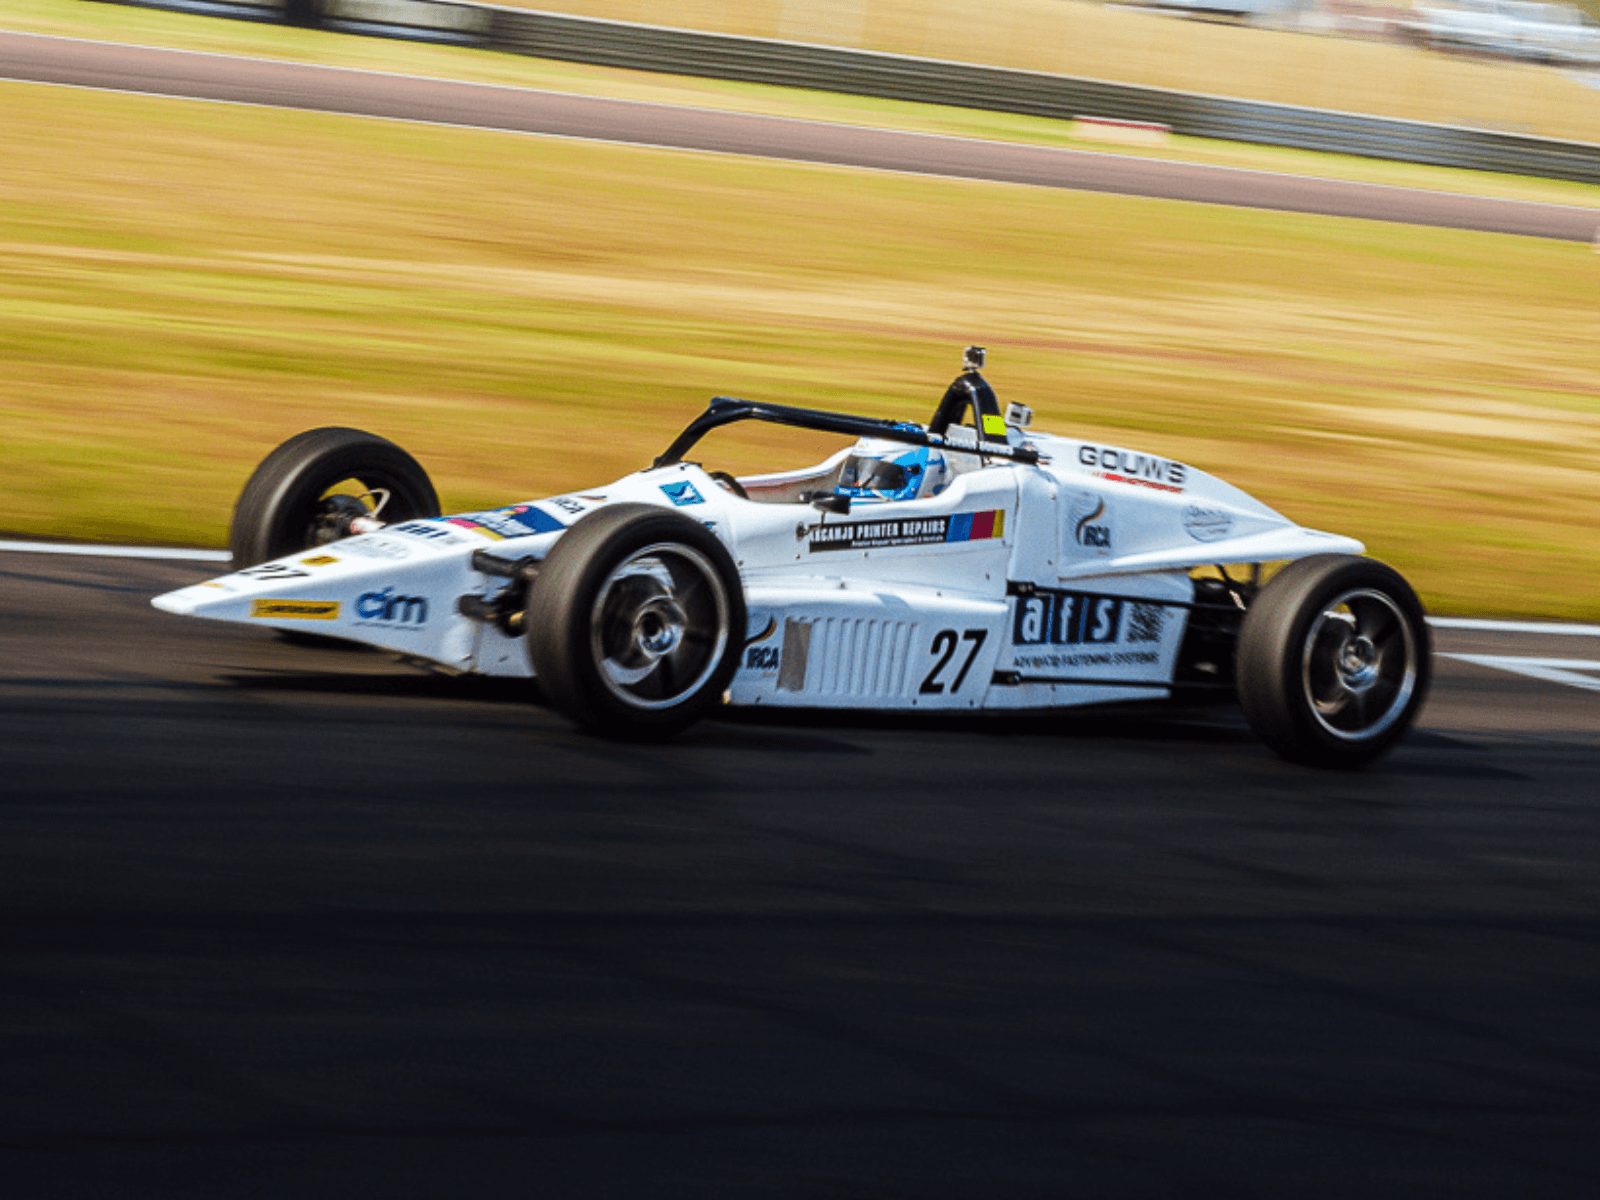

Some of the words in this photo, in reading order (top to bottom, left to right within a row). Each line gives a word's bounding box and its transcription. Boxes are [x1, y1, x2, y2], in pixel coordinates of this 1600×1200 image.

[1079, 445, 1186, 483] GOUWS
[856, 523, 899, 540] PRINTER
[902, 519, 946, 537] REPAIRS
[1021, 598, 1115, 642] afs
[919, 628, 989, 695] 27
